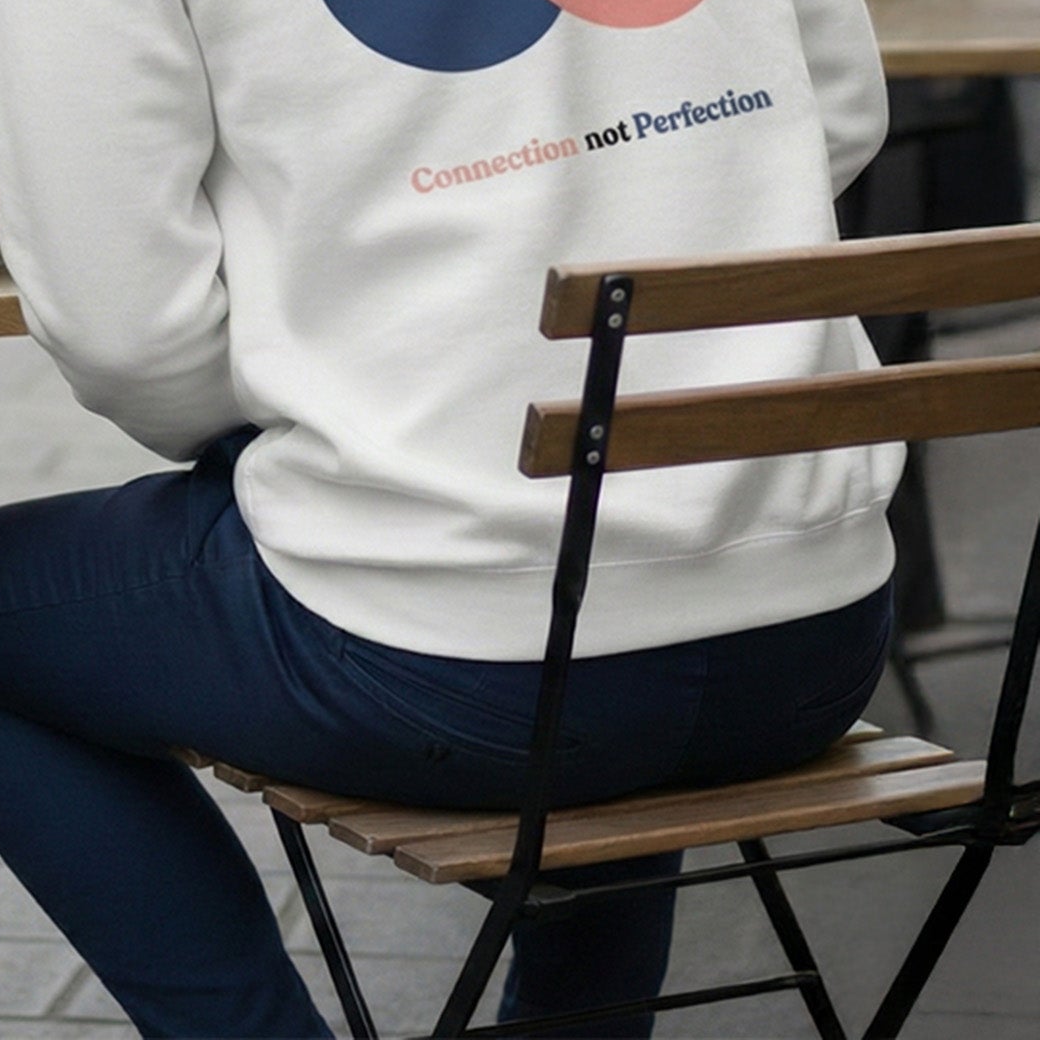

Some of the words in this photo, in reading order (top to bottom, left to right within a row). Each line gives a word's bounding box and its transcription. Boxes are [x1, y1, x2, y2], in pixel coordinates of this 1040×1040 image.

[411, 136, 579, 194] Connection
[584, 120, 631, 151] not
[632, 87, 773, 139] Perfection
